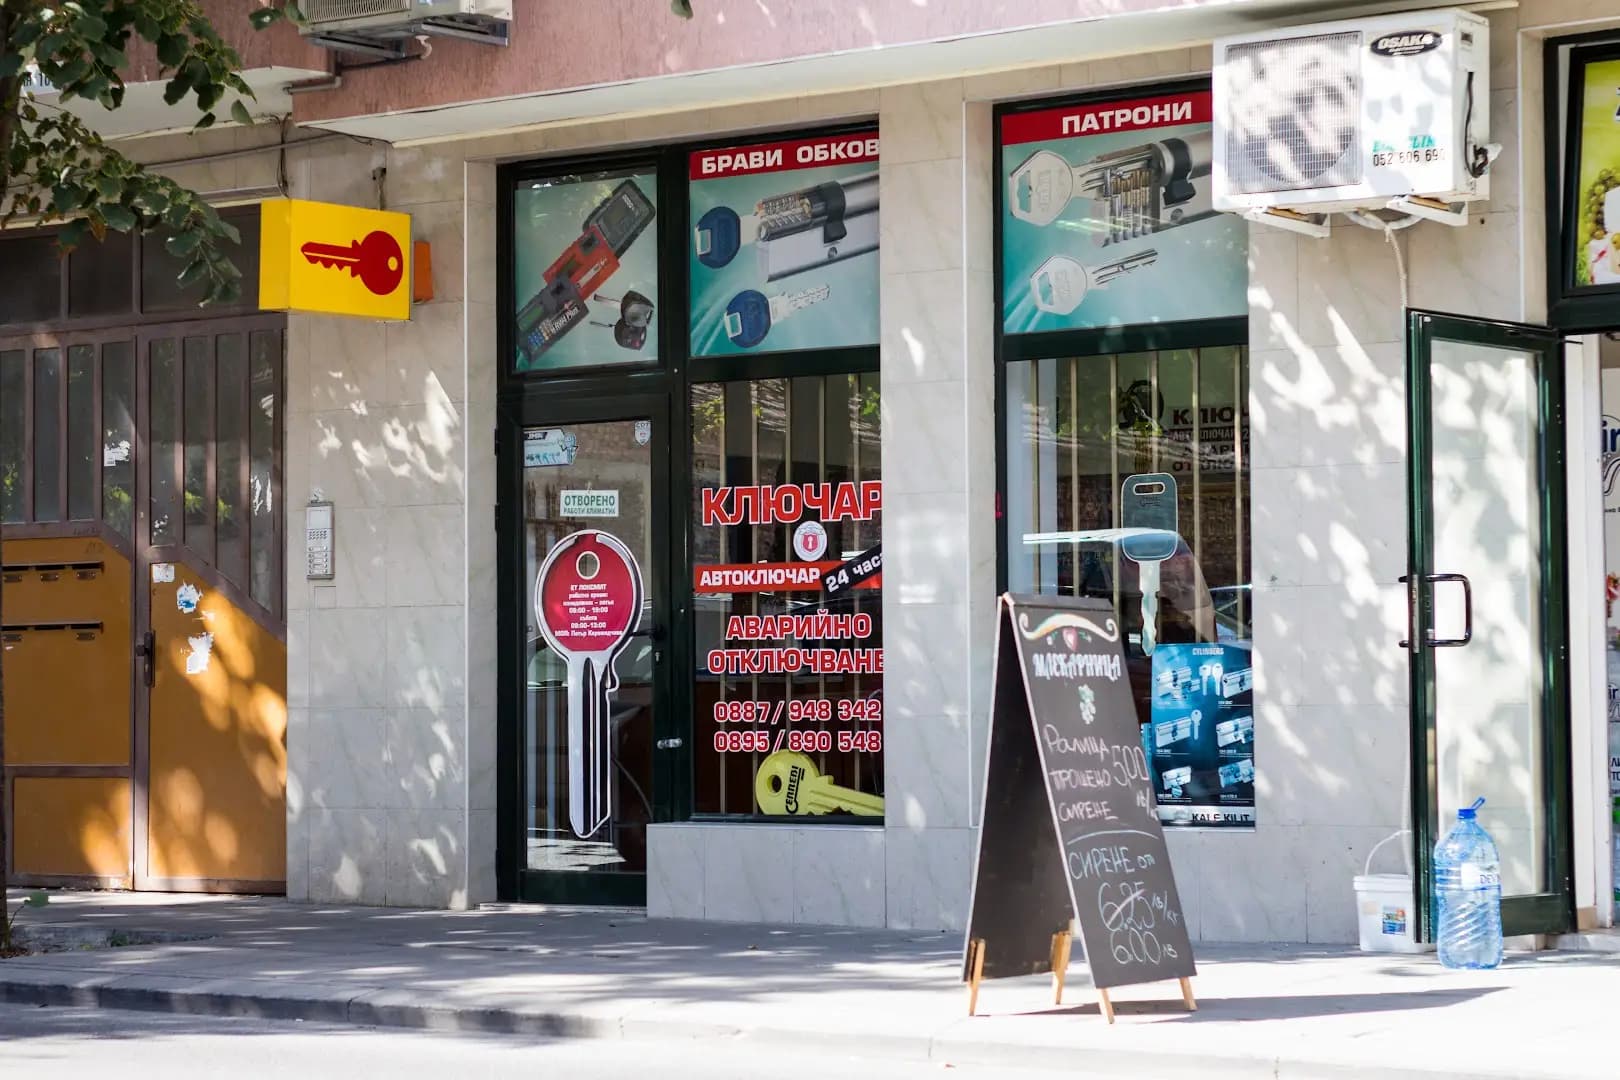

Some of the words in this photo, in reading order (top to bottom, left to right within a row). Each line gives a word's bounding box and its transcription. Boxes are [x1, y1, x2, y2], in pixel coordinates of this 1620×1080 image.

[1377, 33, 1434, 50] OSAKA
[1062, 101, 1192, 135] ПАТРОНИ
[702, 148, 783, 174] БРАВИ
[564, 495, 616, 506] ОТВОРЕНО
[702, 480, 882, 526] КЛЮЧАР
[700, 568, 821, 587] АВТОКЛЮЧАР
[825, 573, 849, 593] 24
[726, 609, 872, 640] АВАРИЙНО
[707, 648, 884, 674] ОТКЛЮЧВАНЕ
[788, 699, 832, 721] 948
[837, 699, 882, 721] 342
[788, 730, 832, 752] 890
[838, 731, 882, 752] 548
[1191, 813, 1221, 822] KALE
[1223, 813, 1251, 822] KILIT
